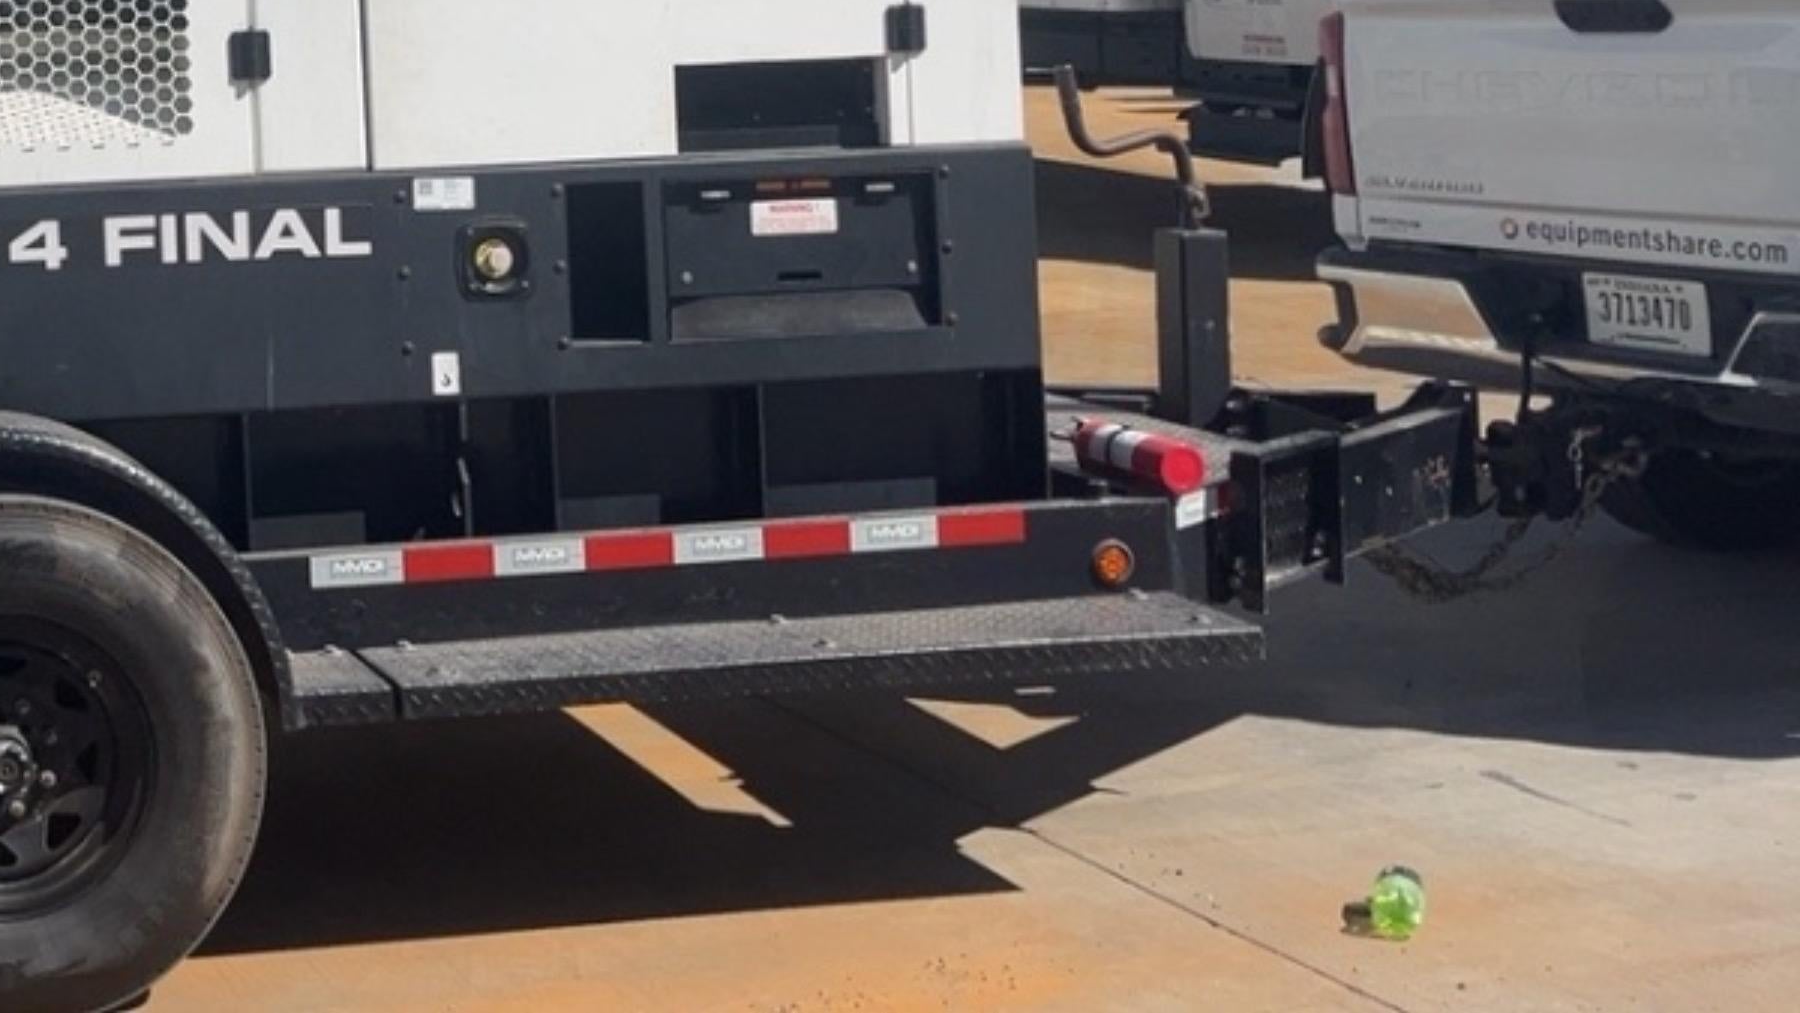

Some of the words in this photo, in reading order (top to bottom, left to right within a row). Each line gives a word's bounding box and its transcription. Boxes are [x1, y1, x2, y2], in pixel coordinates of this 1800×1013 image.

[8, 219, 68, 271] 4
[104, 207, 373, 267] FINAL
[1526, 218, 1789, 264] equipmentshare.com
[1598, 290, 1691, 331] 3713470
